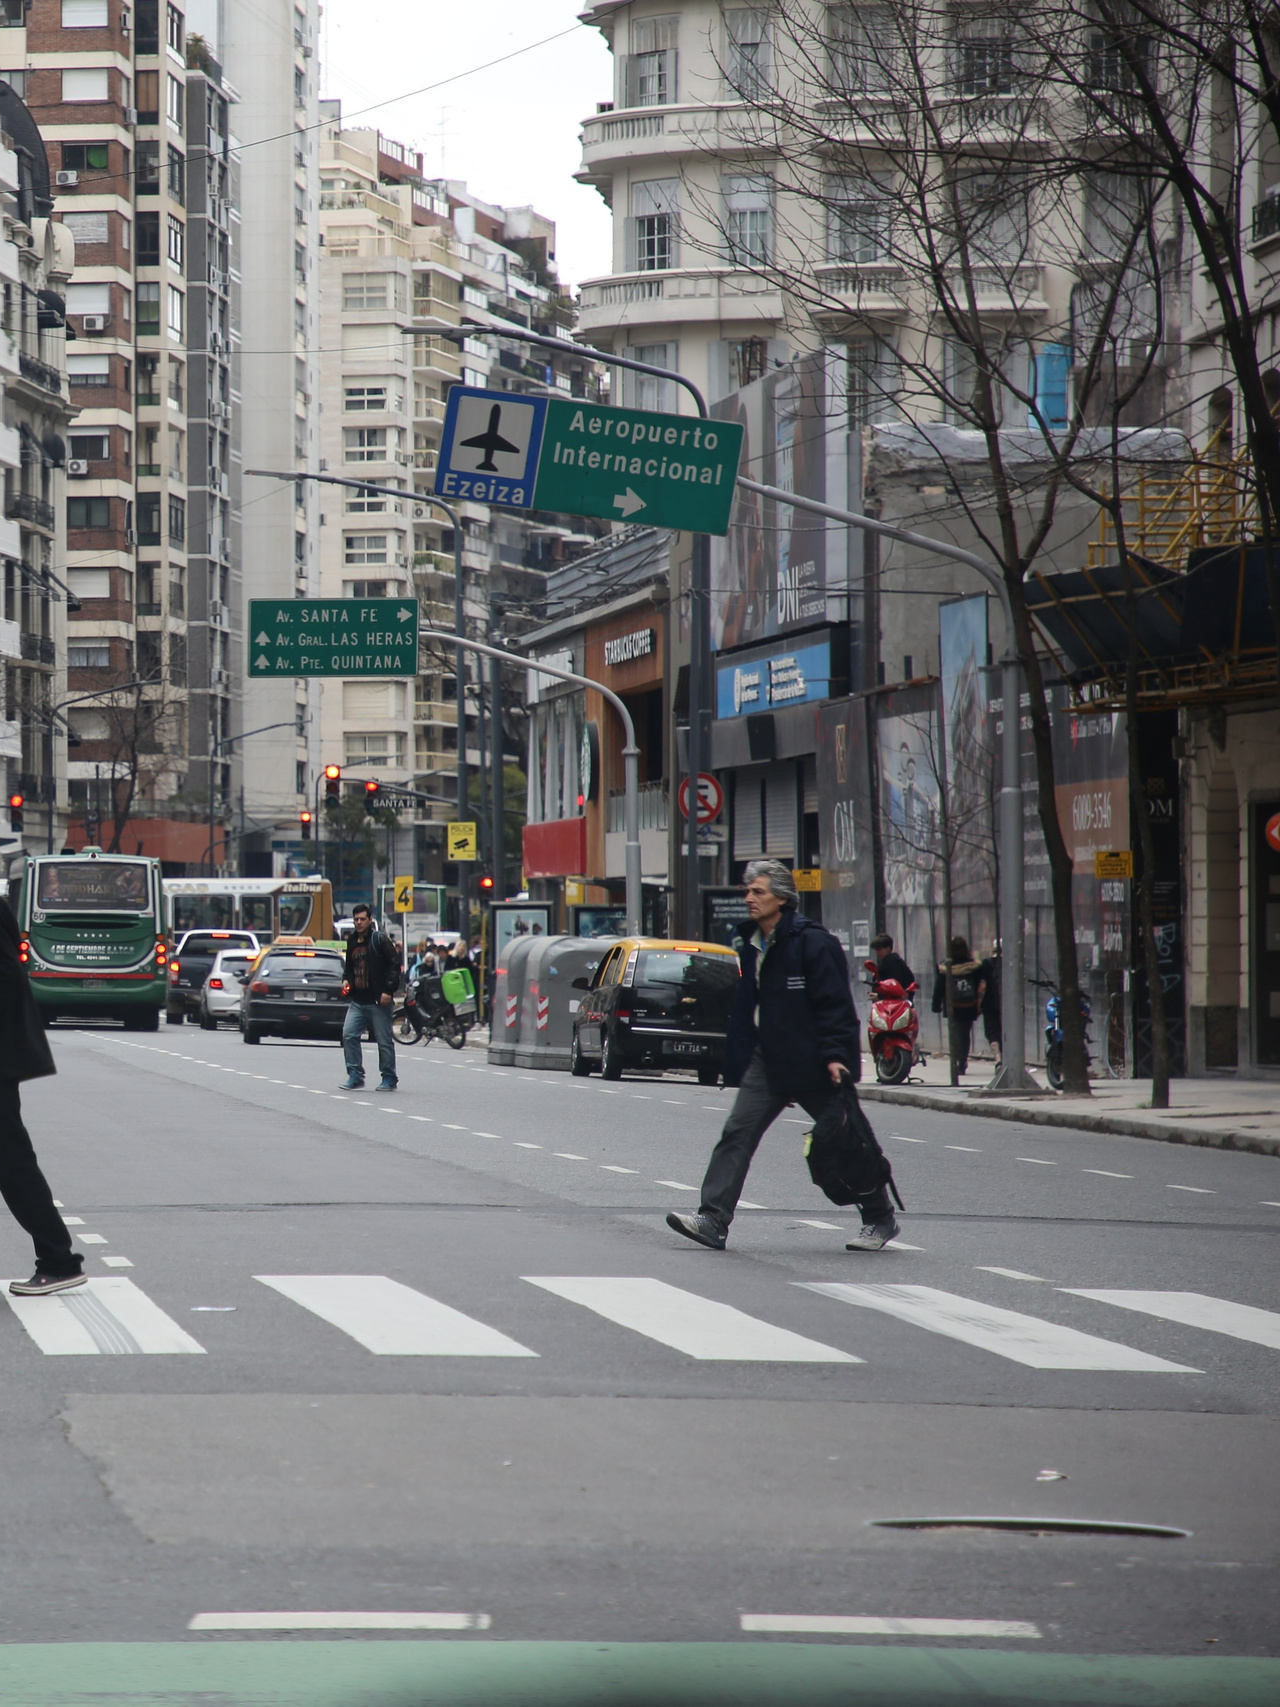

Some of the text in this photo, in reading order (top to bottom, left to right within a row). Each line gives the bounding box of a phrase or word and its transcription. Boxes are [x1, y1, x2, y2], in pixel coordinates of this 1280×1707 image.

[569, 410, 718, 451] Aeropuerto
[552, 442, 724, 486] Internacional
[442, 473, 525, 505] Ezeiza
[777, 565, 799, 625] DNI
[301, 609, 349, 623] SANTA
[361, 608, 378, 623] FE
[331, 632, 358, 645] LAS
[367, 632, 413, 645] HERAS
[605, 627, 651, 666] STARBUCKS COFFEE
[331, 655, 402, 670] QUINTANA
[373, 799, 417, 808] SANTA FE
[1072, 791, 1112, 831] 6009-3546
[397, 886, 410, 906] 4
[34, 912, 45, 921] 60
[66, 945, 106, 954] SEPTIEMBRE
